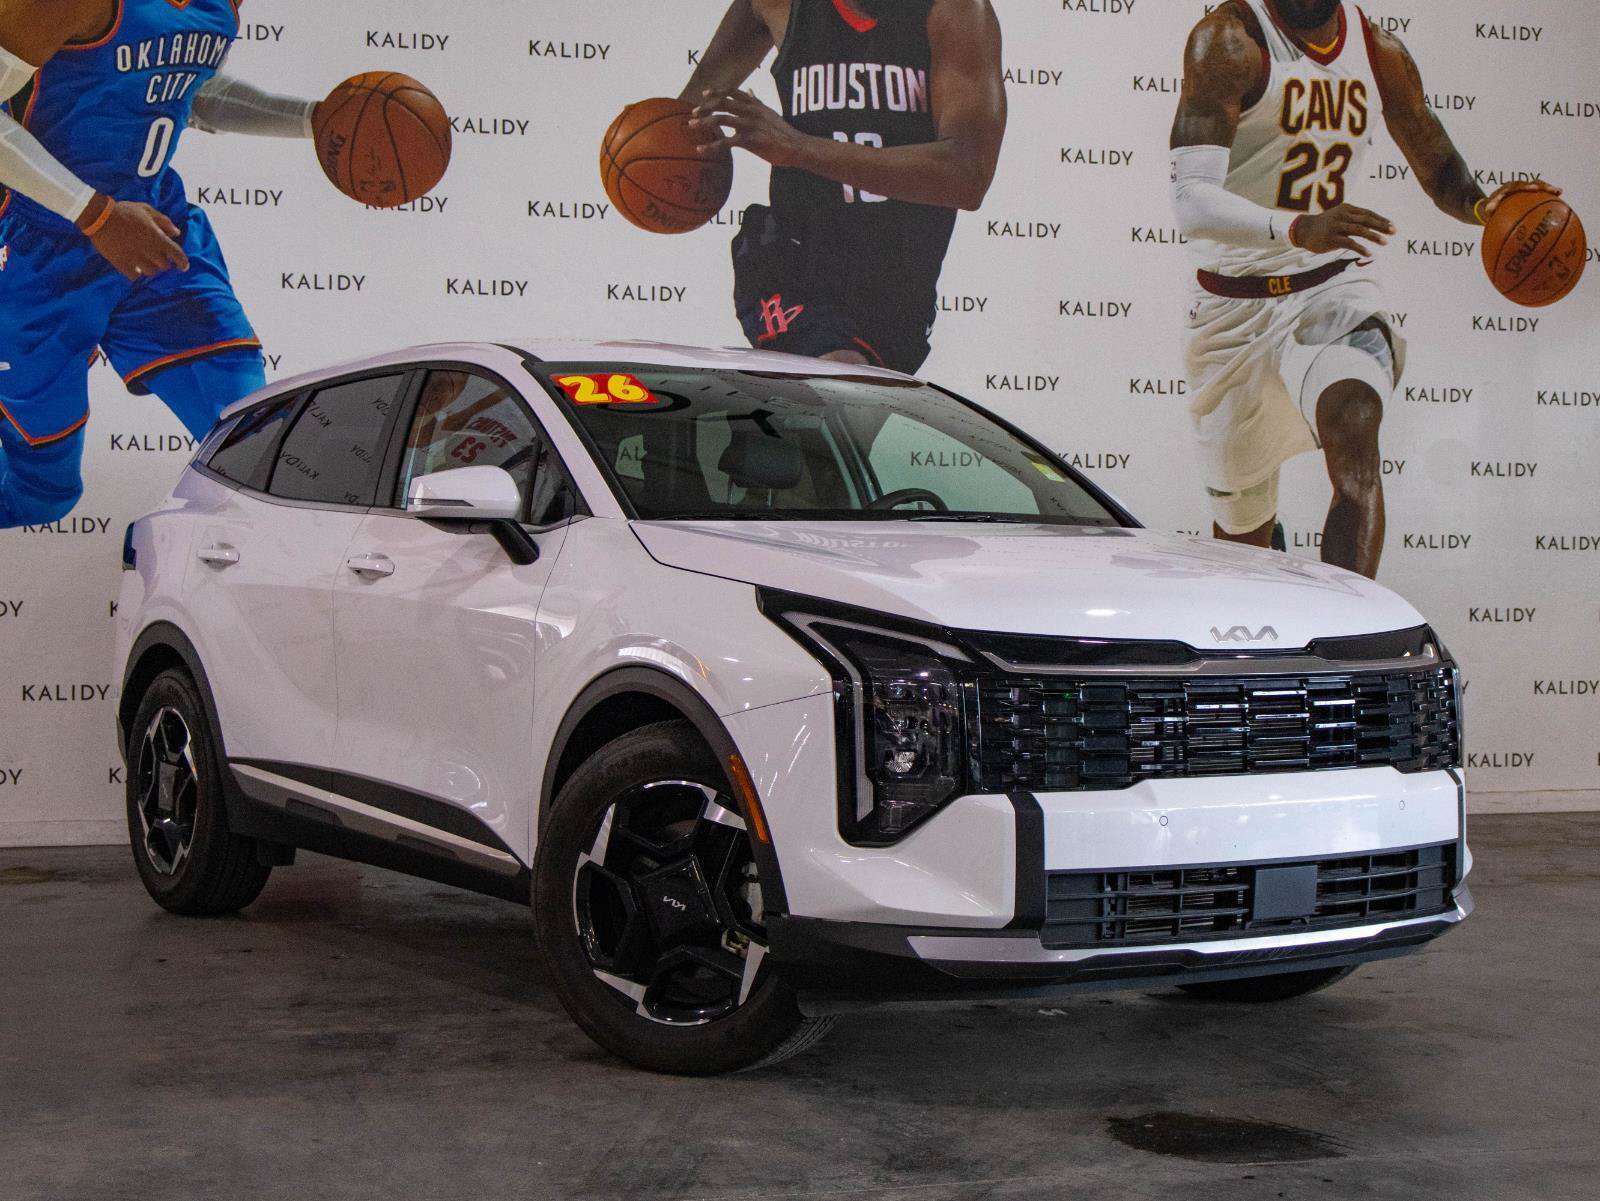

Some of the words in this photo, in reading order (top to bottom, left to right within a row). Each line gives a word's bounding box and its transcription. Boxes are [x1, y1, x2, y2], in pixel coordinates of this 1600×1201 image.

[1062, 0, 1135, 14] KALIDY
[234, 24, 284, 41] IDY
[1369, 16, 1411, 33] IDY
[1475, 23, 1543, 42] KALIDY
[366, 30, 450, 51] KALIDY
[528, 39, 611, 60] KALIDY
[115, 32, 229, 72] OKLAHOM
[1002, 68, 1063, 86] ALIDY
[1133, 75, 1185, 93] KALI
[146, 72, 197, 103] CITY
[791, 62, 928, 117] HOUSTON
[1280, 77, 1367, 136] CAVS
[1424, 94, 1476, 111] ALIDY
[448, 116, 530, 136] KALIDY
[137, 116, 175, 178] 0
[1060, 148, 1134, 166] KALIDY
[1275, 141, 1353, 213] 23
[1370, 164, 1410, 181] IDY
[197, 187, 284, 207] KALIDY
[527, 200, 609, 220] KALIDY
[987, 220, 1062, 239] KALIDY
[1407, 239, 1475, 257] KALIDY
[281, 272, 366, 292] KALIDY
[446, 278, 529, 297] KALIDY
[1267, 276, 1292, 295] CLE
[607, 283, 687, 303] KALIDY
[935, 296, 988, 312] LIDY
[1059, 299, 1133, 318] KALIDY
[1472, 315, 1540, 333] KALIDY
[558, 374, 650, 403] 26
[986, 374, 1060, 392] KALIDY
[1129, 378, 1187, 395] KALID
[1405, 386, 1473, 403] KALIDY
[1537, 390, 1600, 407] KALIDY
[111, 433, 196, 452] KALIDY
[910, 450, 985, 468] KALIDY
[1471, 461, 1538, 478] KALIDY
[1294, 532, 1323, 548] LID
[1403, 533, 1472, 549] KALIDY
[1535, 535, 1600, 551] KALIDY
[1469, 607, 1536, 623] KALIDY
[22, 683, 111, 701] KALIDY
[1533, 679, 1600, 695] KALIDY
[1467, 752, 1535, 768] KALIDY
